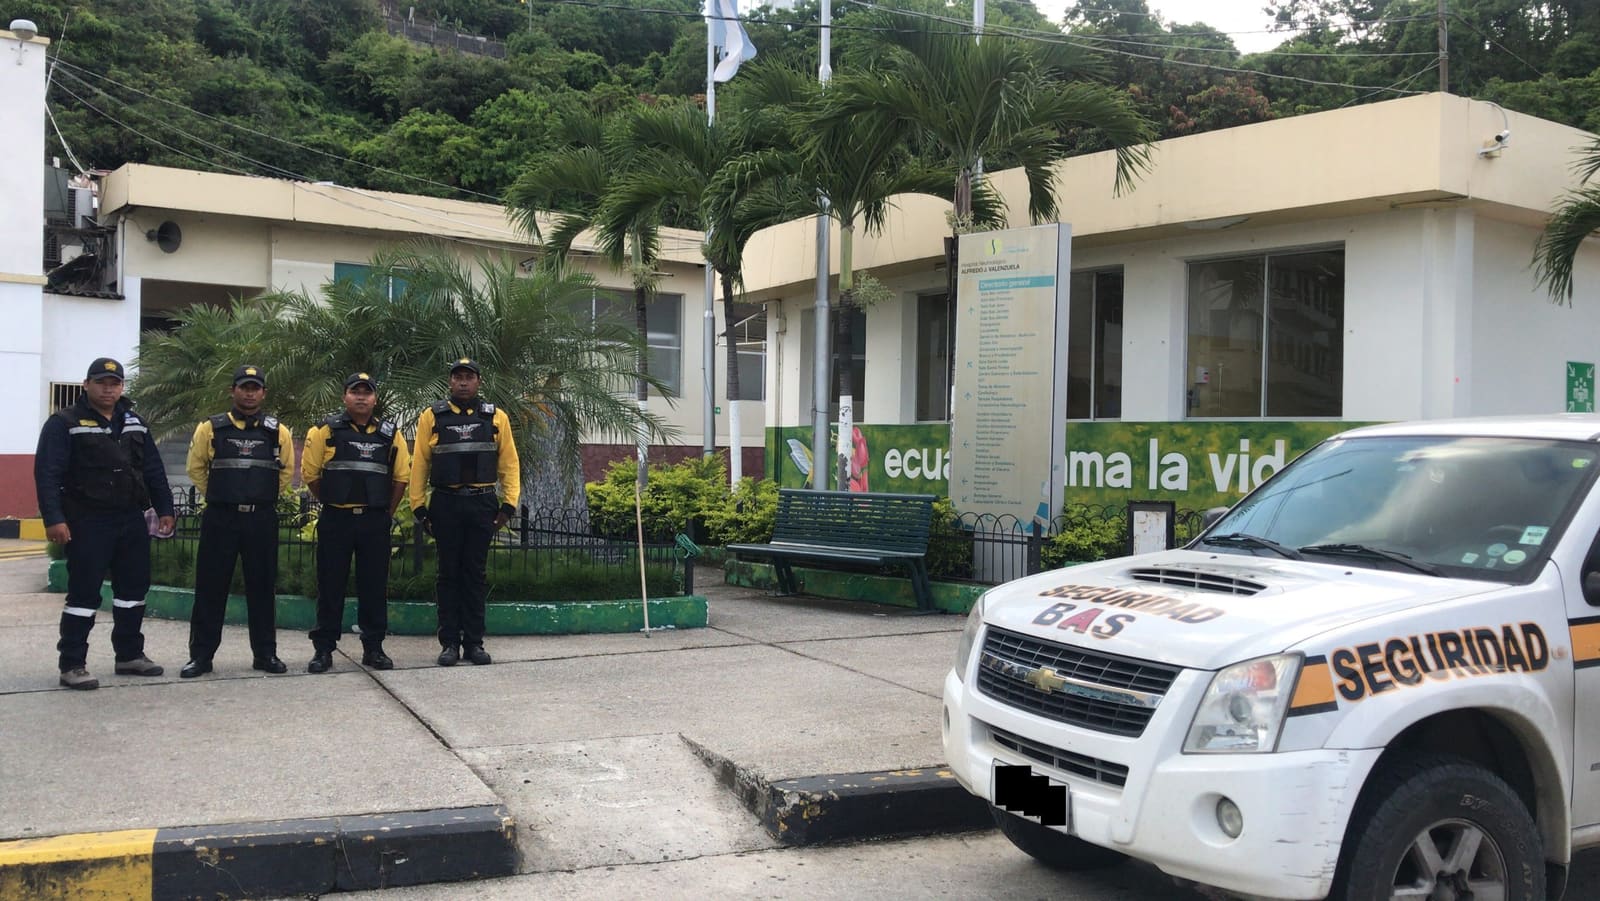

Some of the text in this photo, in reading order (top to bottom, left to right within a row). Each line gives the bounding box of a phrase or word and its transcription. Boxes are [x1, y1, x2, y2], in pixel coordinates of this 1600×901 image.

[988, 264, 1020, 272] VALENZUELA
[1149, 438, 1188, 491] la
[1031, 603, 1136, 640] BAS
[1038, 584, 1225, 624] SEGURIDAD
[1331, 620, 1549, 702] SEGURIDAD
